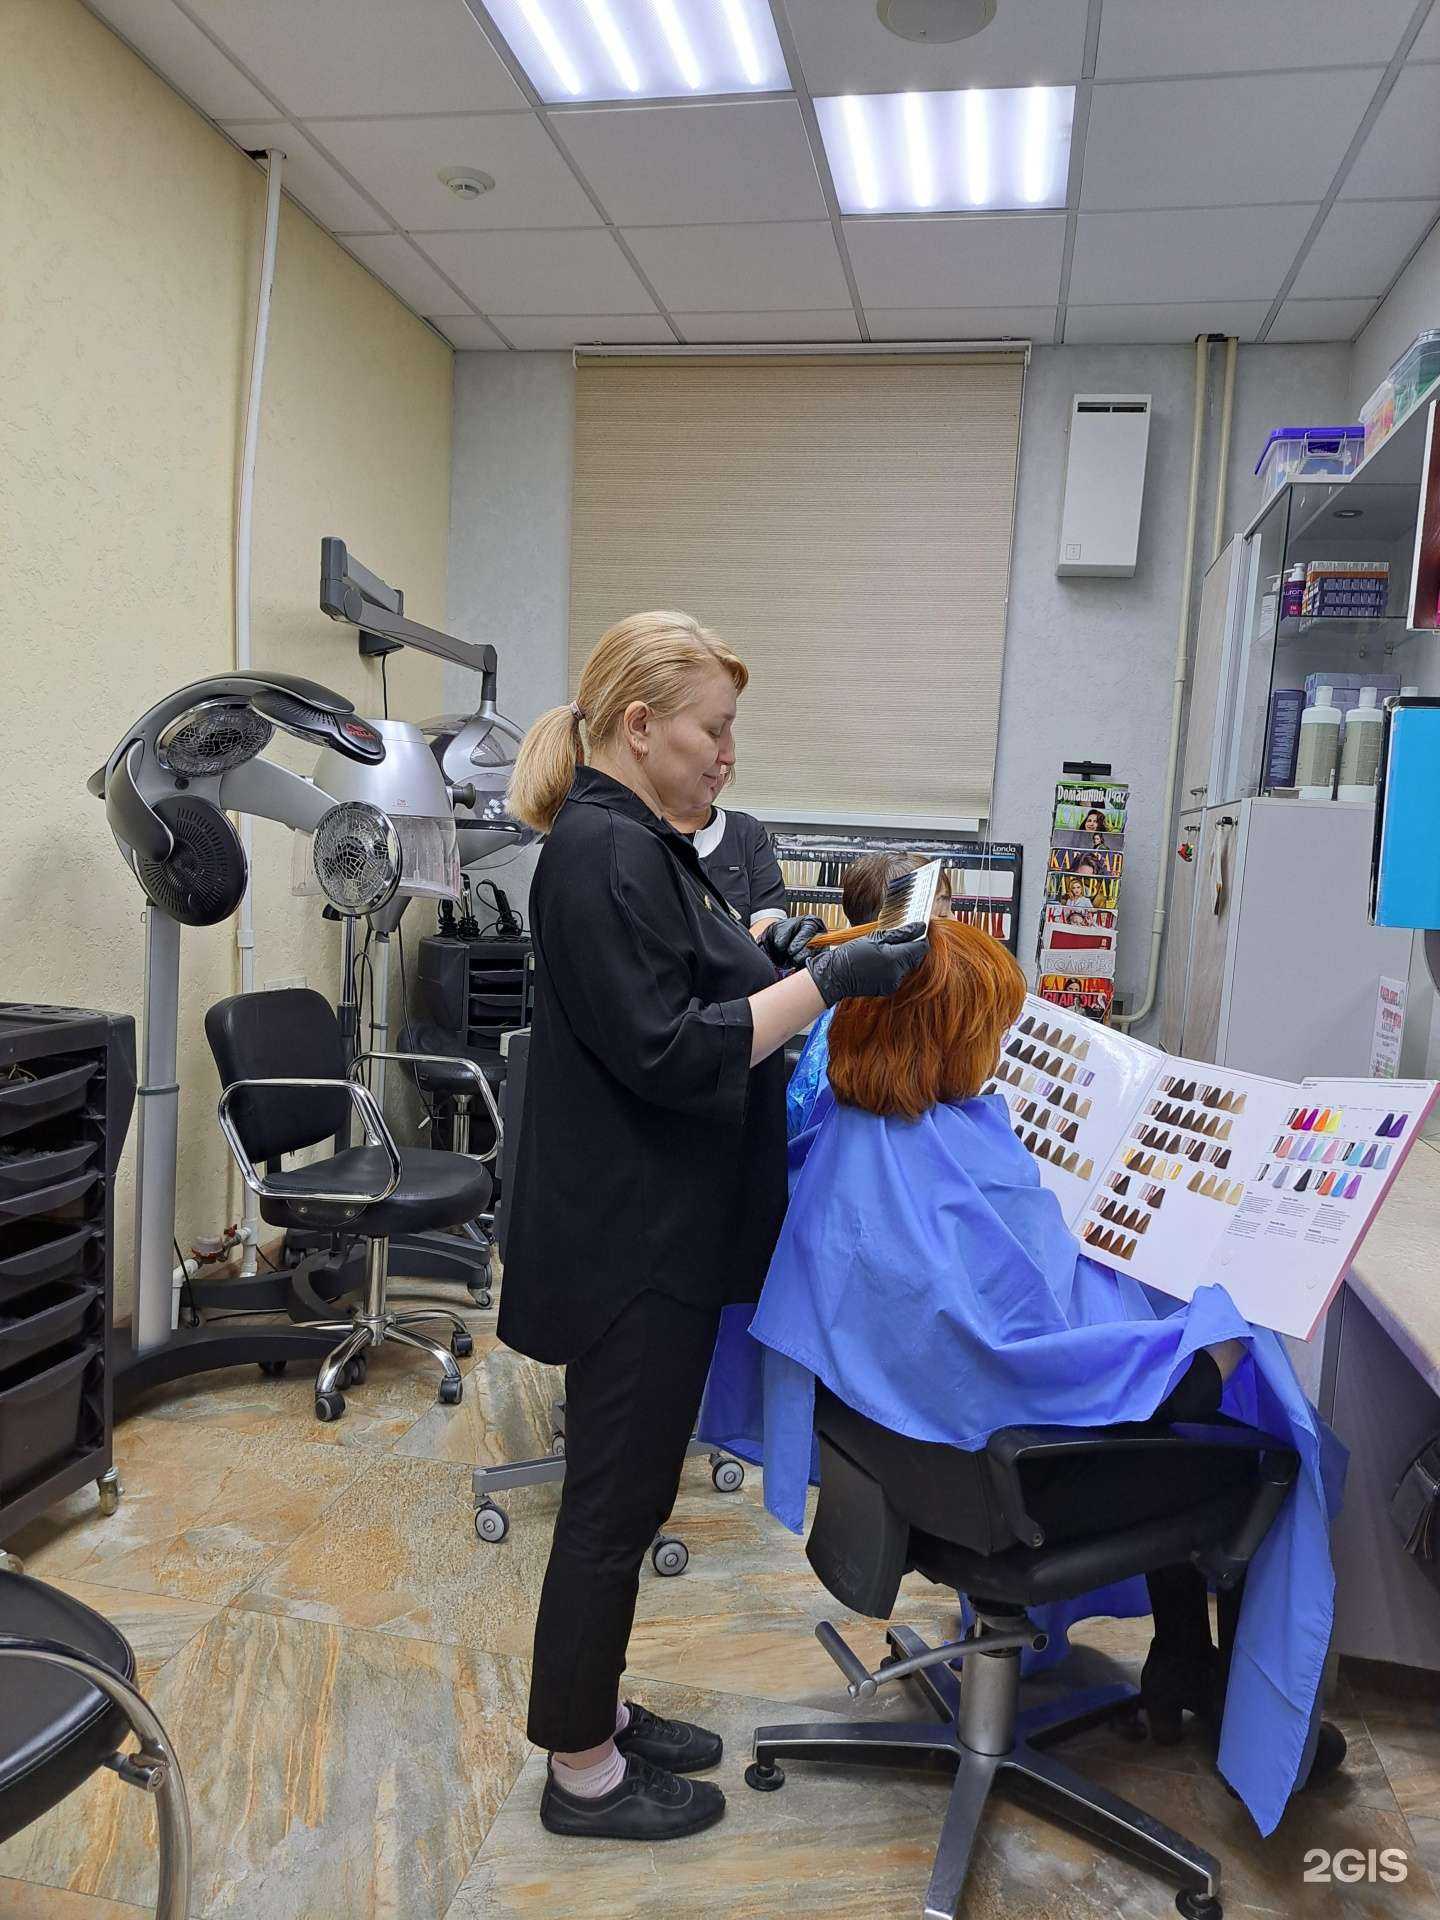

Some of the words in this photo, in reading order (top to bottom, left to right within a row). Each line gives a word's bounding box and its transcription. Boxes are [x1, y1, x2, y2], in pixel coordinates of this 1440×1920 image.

[993, 844, 1016, 853] Londa
[1050, 849, 1122, 874] КААН
[1046, 874, 1119, 897] КАВАН
